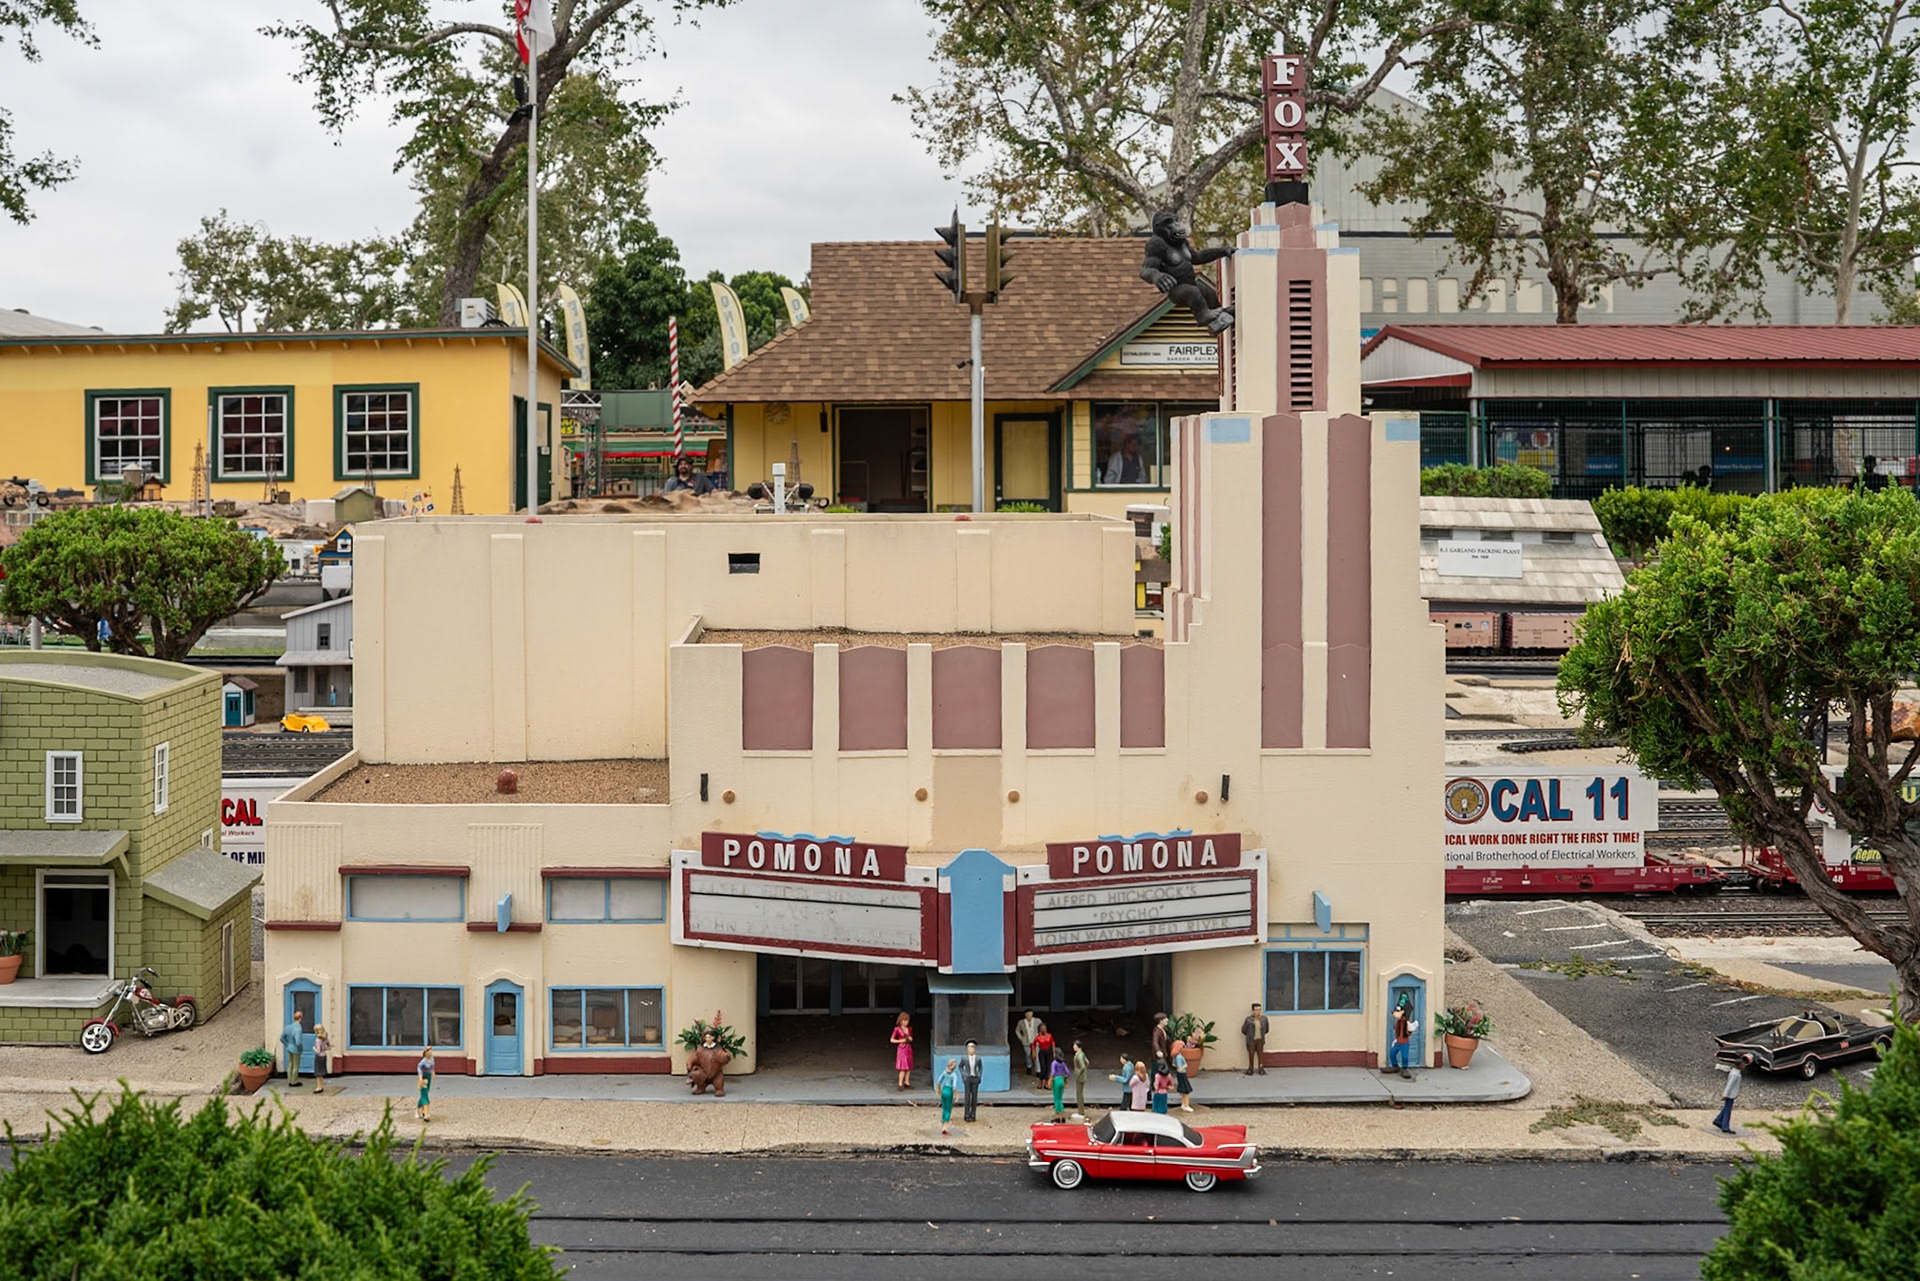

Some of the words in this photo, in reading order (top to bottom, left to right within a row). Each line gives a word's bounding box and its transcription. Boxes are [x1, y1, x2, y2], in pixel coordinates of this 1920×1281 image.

[1272, 58, 1303, 170] FOX
[1169, 346, 1218, 356] FAIRPLEX
[221, 798, 263, 826] CAL
[1491, 778, 1573, 823] CAL
[1585, 776, 1629, 821] 11
[1469, 834, 1499, 846] WORK
[1501, 833, 1528, 845] DONE
[1530, 833, 1559, 845] RIGHT
[1561, 832, 1579, 844] THE
[1581, 832, 1608, 844] FIRST
[1613, 832, 1640, 844] TIME!
[723, 838, 881, 877] POMONA
[1072, 838, 1218, 875] POMONA
[1476, 850, 1538, 861] Brotherhood
[1540, 849, 1550, 861] of
[1551, 849, 1596, 861] Electrical
[1597, 849, 1636, 861] Workers
[1832, 875, 1844, 884] 48
[1049, 894, 1097, 908] ALFRED
[1107, 885, 1197, 905] HITCHCOCK'S
[1039, 931, 1080, 946] JOHN
[1187, 917, 1230, 932] RIVER
